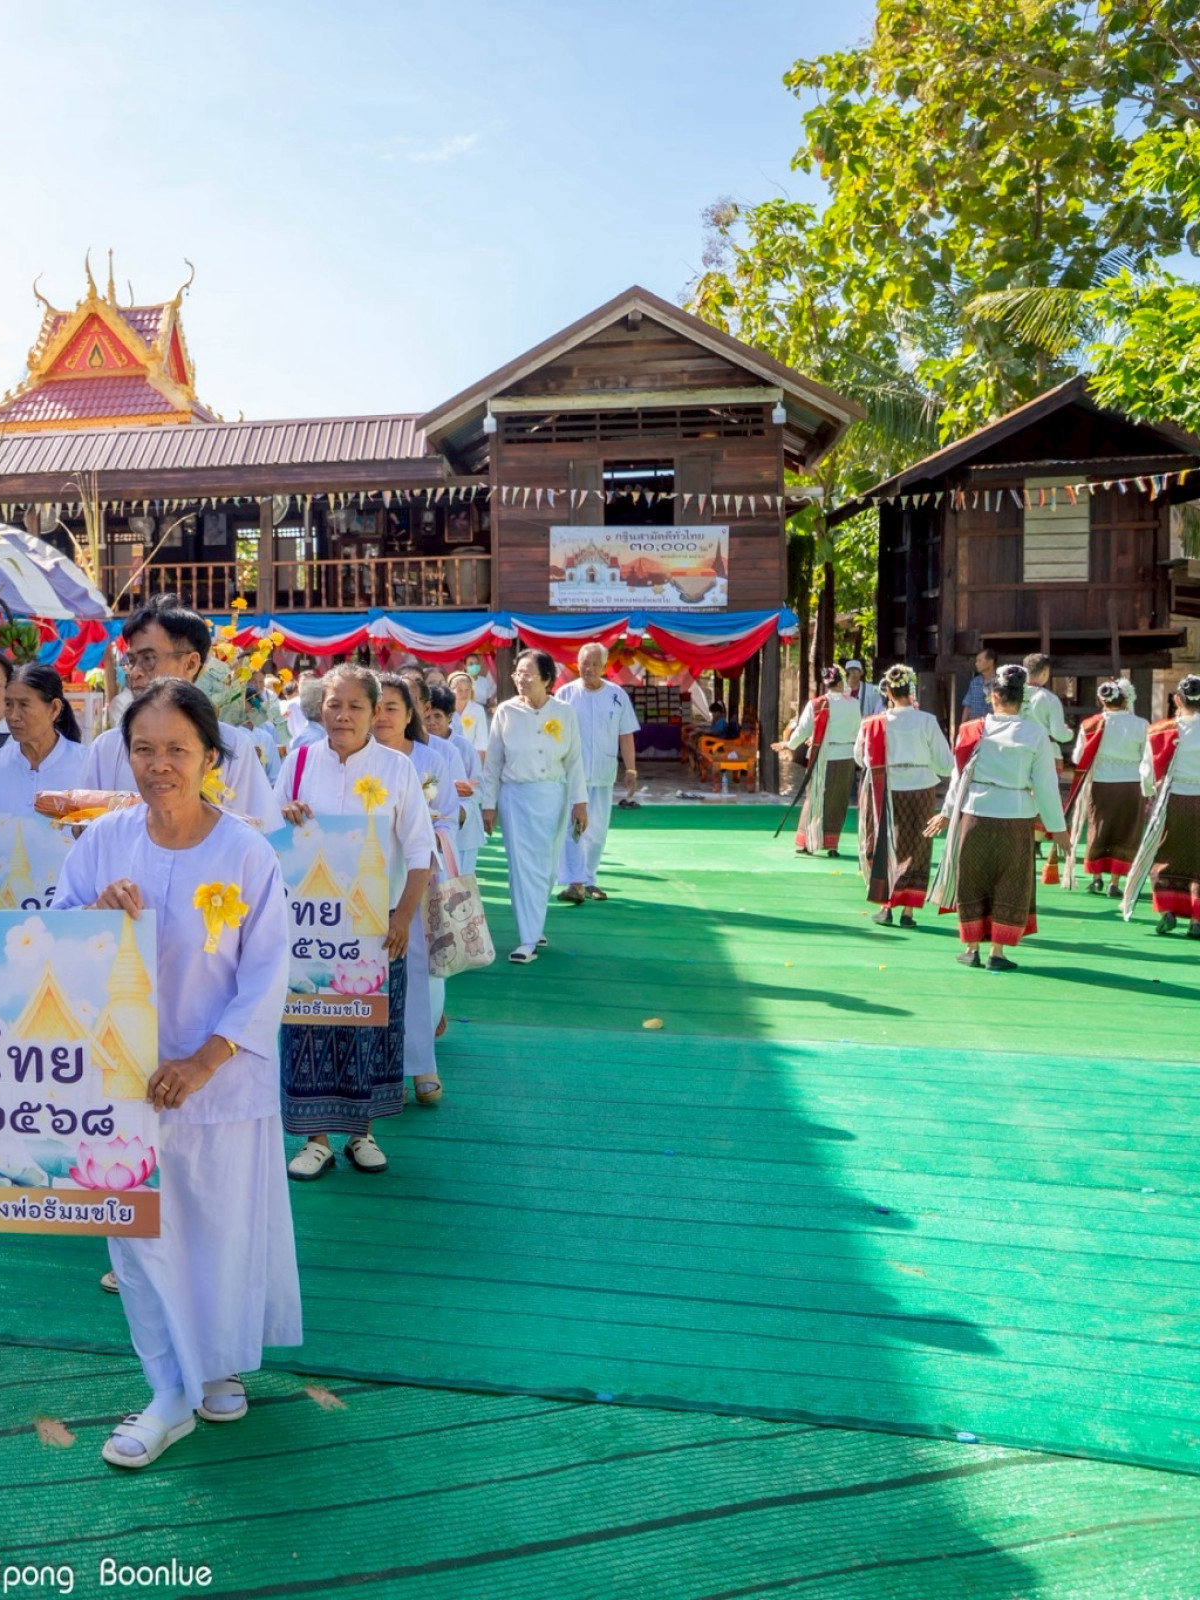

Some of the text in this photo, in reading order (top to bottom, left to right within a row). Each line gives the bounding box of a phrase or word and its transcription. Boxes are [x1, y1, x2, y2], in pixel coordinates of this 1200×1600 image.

[290, 899, 341, 927] ทย
[292, 938, 360, 960] ๕๖๘
[284, 1001, 370, 1016] งพ่อธัมมชโย
